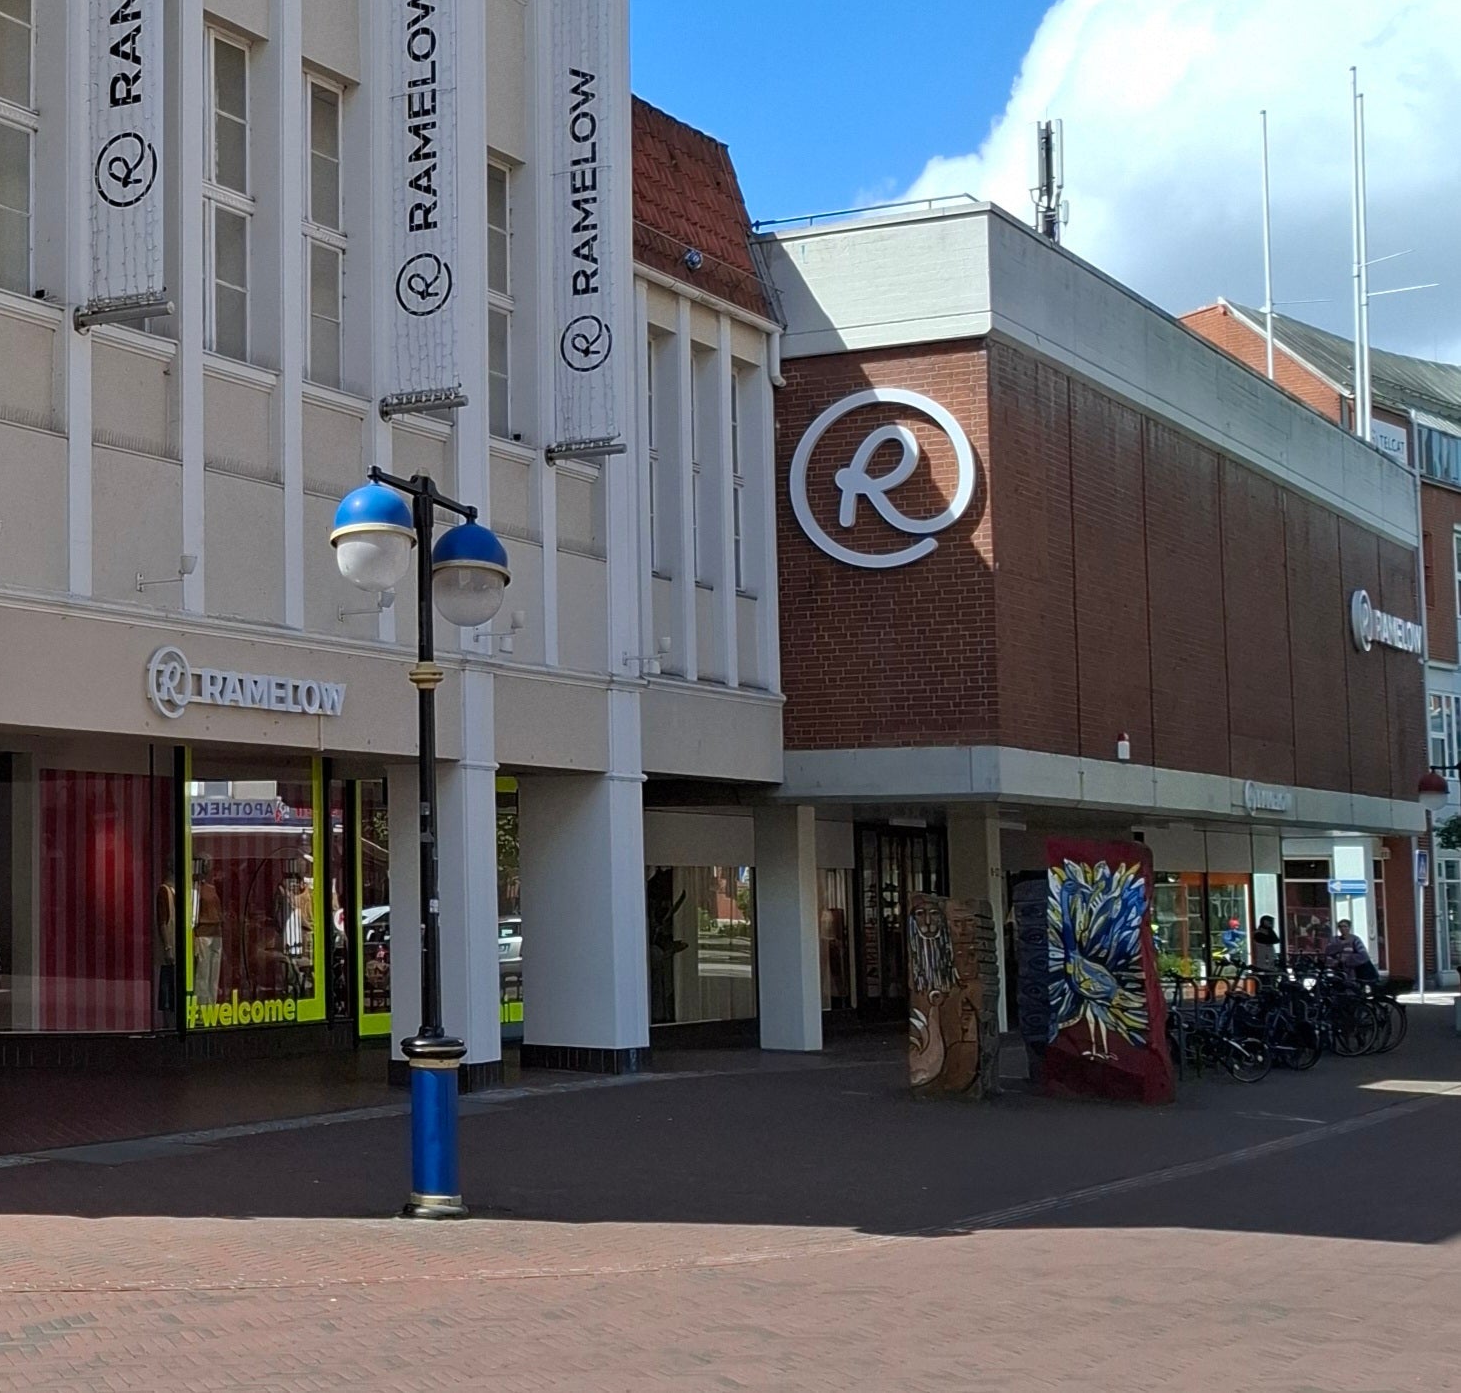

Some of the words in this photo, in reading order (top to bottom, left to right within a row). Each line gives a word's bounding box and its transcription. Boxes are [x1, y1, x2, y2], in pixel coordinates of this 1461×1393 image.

[568, 67, 600, 297] RAMELOW
[790, 387, 977, 569] R
[1372, 609, 1423, 655] RAMELOW
[201, 667, 347, 717] RAMELOW
[186, 989, 296, 1029] #welcome
